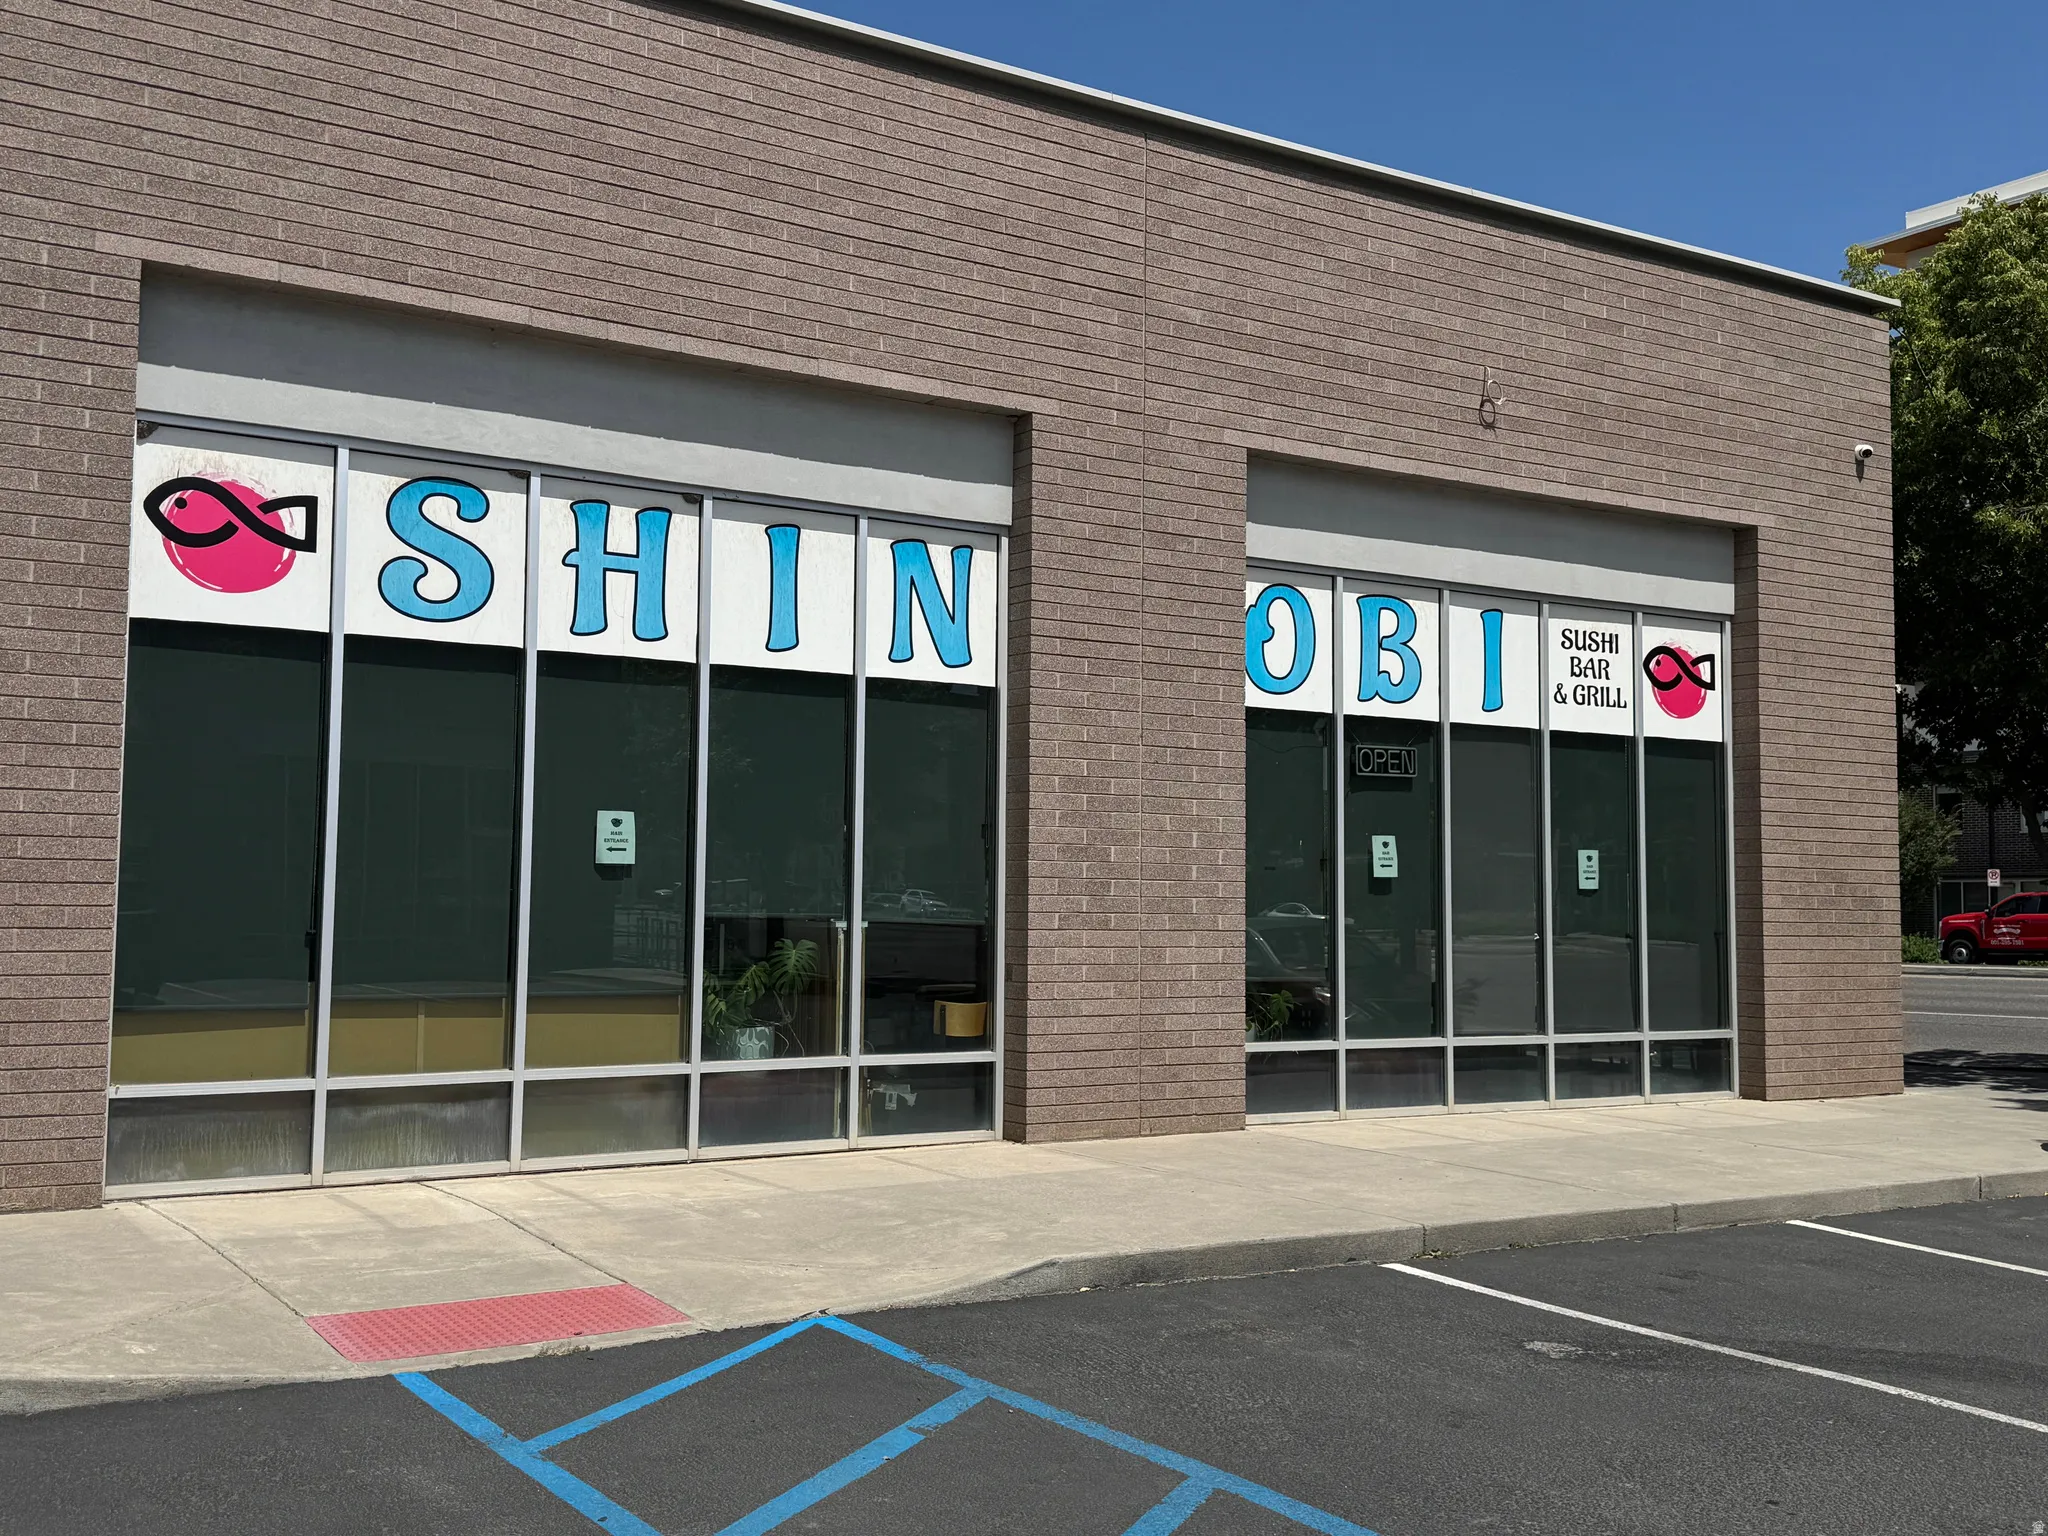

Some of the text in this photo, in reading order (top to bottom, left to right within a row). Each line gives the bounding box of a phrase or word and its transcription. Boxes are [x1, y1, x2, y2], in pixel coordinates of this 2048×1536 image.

[1561, 628, 1619, 654] SUSHI
[1570, 656, 1610, 680] BAR
[1553, 682, 1627, 708] & GRILL
[1360, 749, 1414, 773] OPEN
